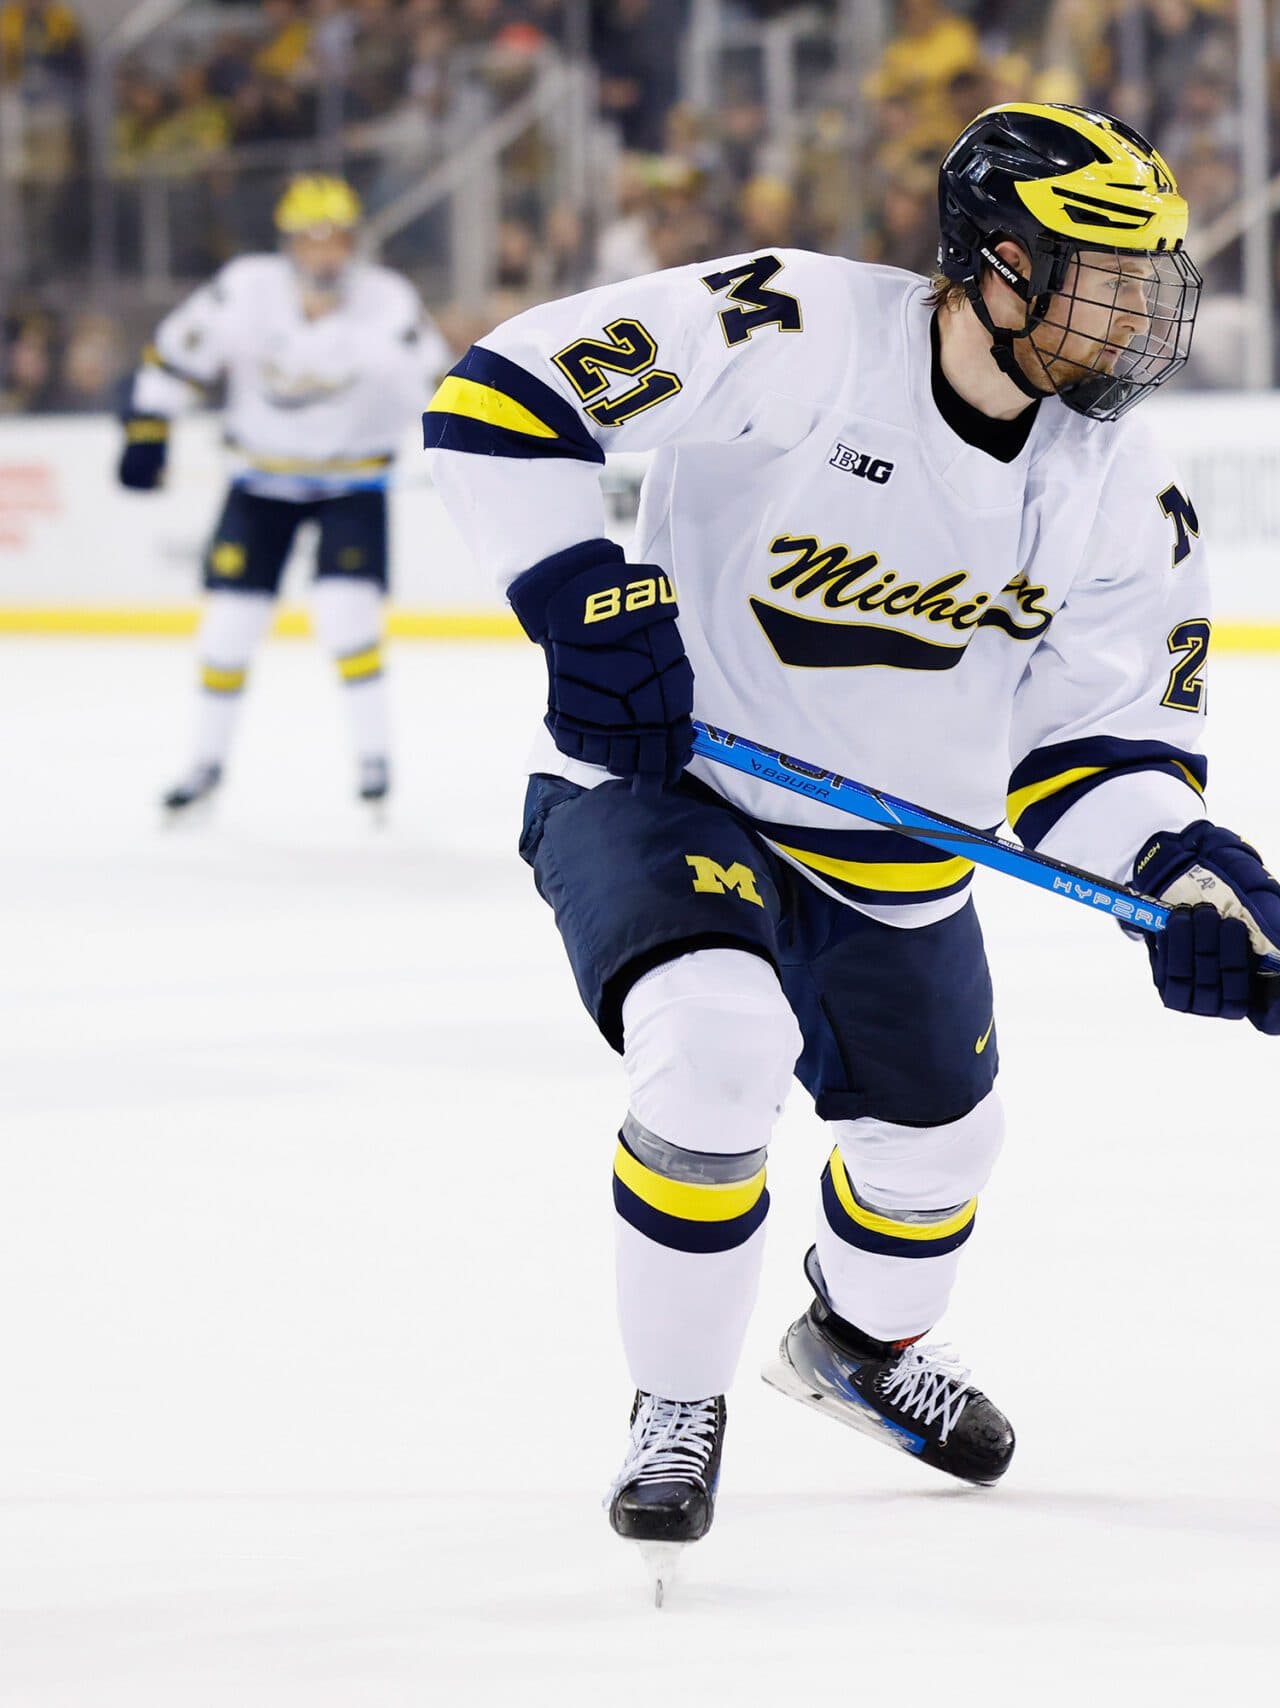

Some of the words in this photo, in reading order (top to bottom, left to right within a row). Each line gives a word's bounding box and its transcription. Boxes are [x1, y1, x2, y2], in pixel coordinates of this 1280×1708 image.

[700, 255, 803, 347] M
[981, 247, 1018, 284] BAUER
[550, 317, 683, 428] 21
[1159, 617, 1212, 716] 2
[763, 767, 831, 800] BAUER
[684, 854, 765, 909] M
